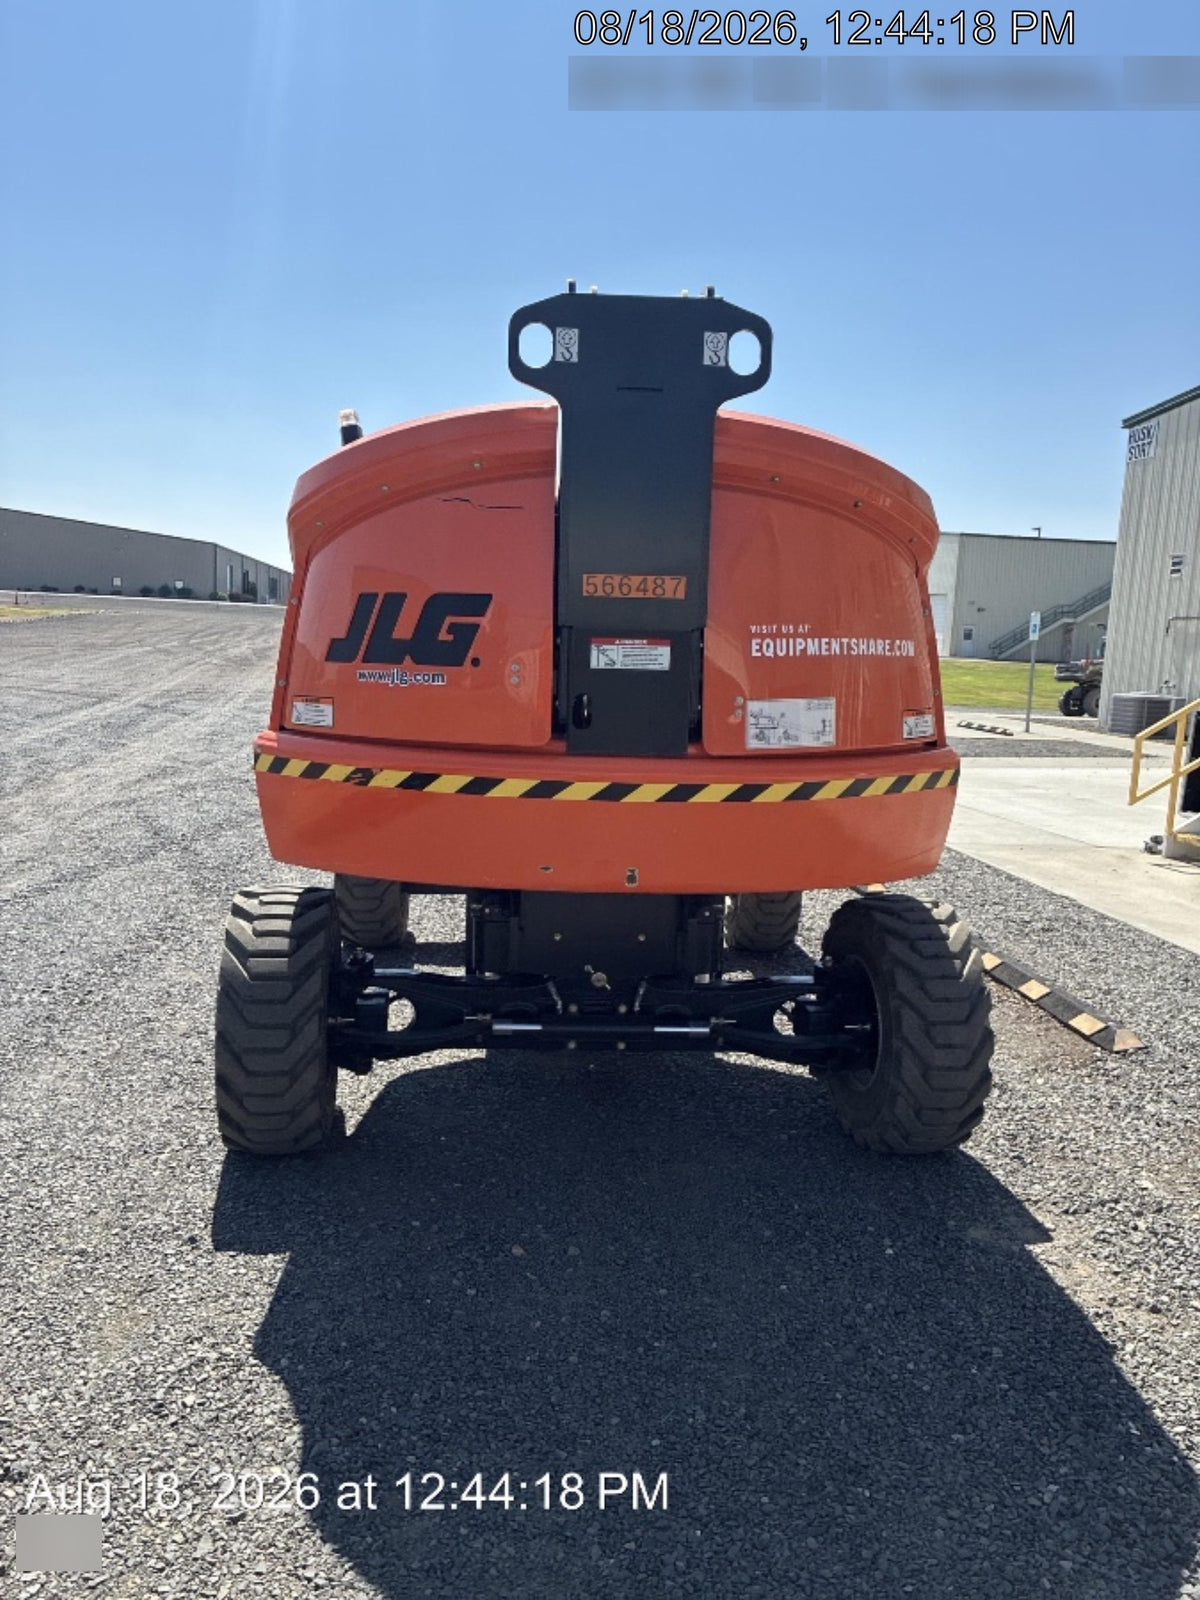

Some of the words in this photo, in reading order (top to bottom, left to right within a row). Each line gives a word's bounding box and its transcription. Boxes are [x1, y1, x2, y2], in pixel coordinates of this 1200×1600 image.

[585, 576, 682, 596] 566487
[325, 592, 493, 667] JLG
[750, 624, 777, 634] VISIT
[782, 624, 794, 634] US
[797, 624, 811, 634] AT
[751, 638, 915, 658] EQUIPMENTSHARE.COM
[357, 667, 446, 686] www.jlg.com
